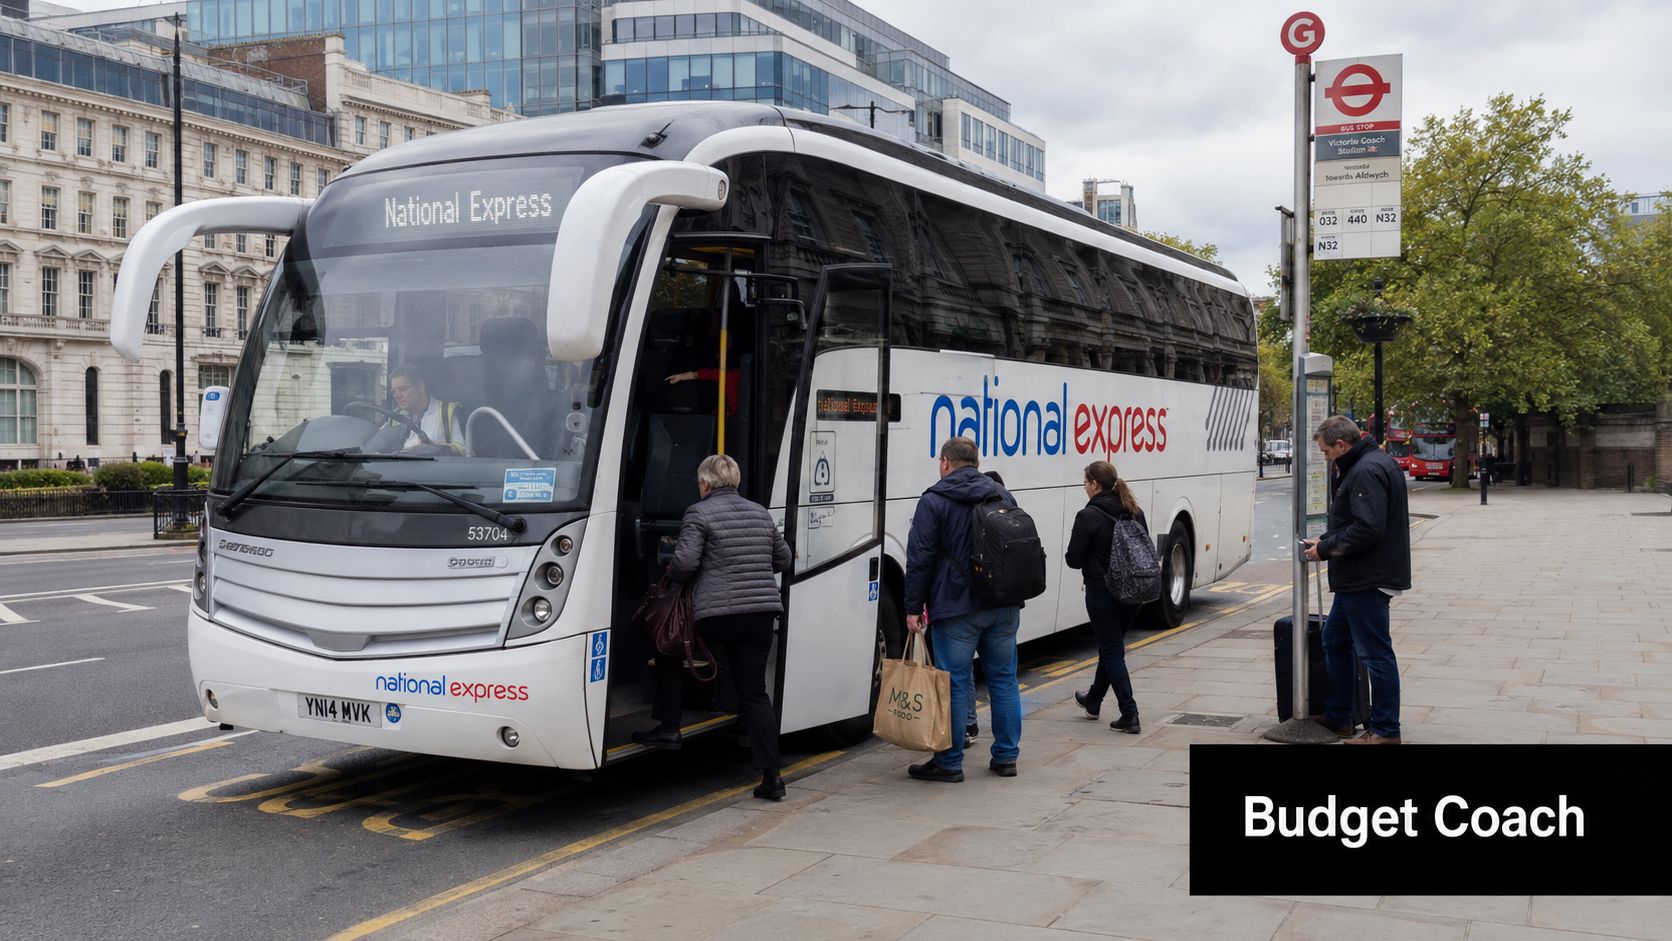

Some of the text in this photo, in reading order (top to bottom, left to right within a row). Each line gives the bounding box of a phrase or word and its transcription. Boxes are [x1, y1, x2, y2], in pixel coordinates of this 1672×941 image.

[1288, 18, 1316, 48] G
[1356, 123, 1375, 131] STOP
[1360, 135, 1386, 145] Coach
[1355, 170, 1389, 180] Aldwych
[385, 190, 552, 228] National Express
[1319, 216, 1338, 226] 032
[1347, 214, 1368, 224] 440
[1376, 213, 1397, 223] N32
[1318, 240, 1338, 251] N32
[930, 374, 1167, 462] national express
[467, 526, 508, 541] 53704
[376, 672, 529, 703] national express
[888, 687, 923, 713] M&S
[305, 696, 338, 719] YN14
[341, 699, 372, 724] MVK
